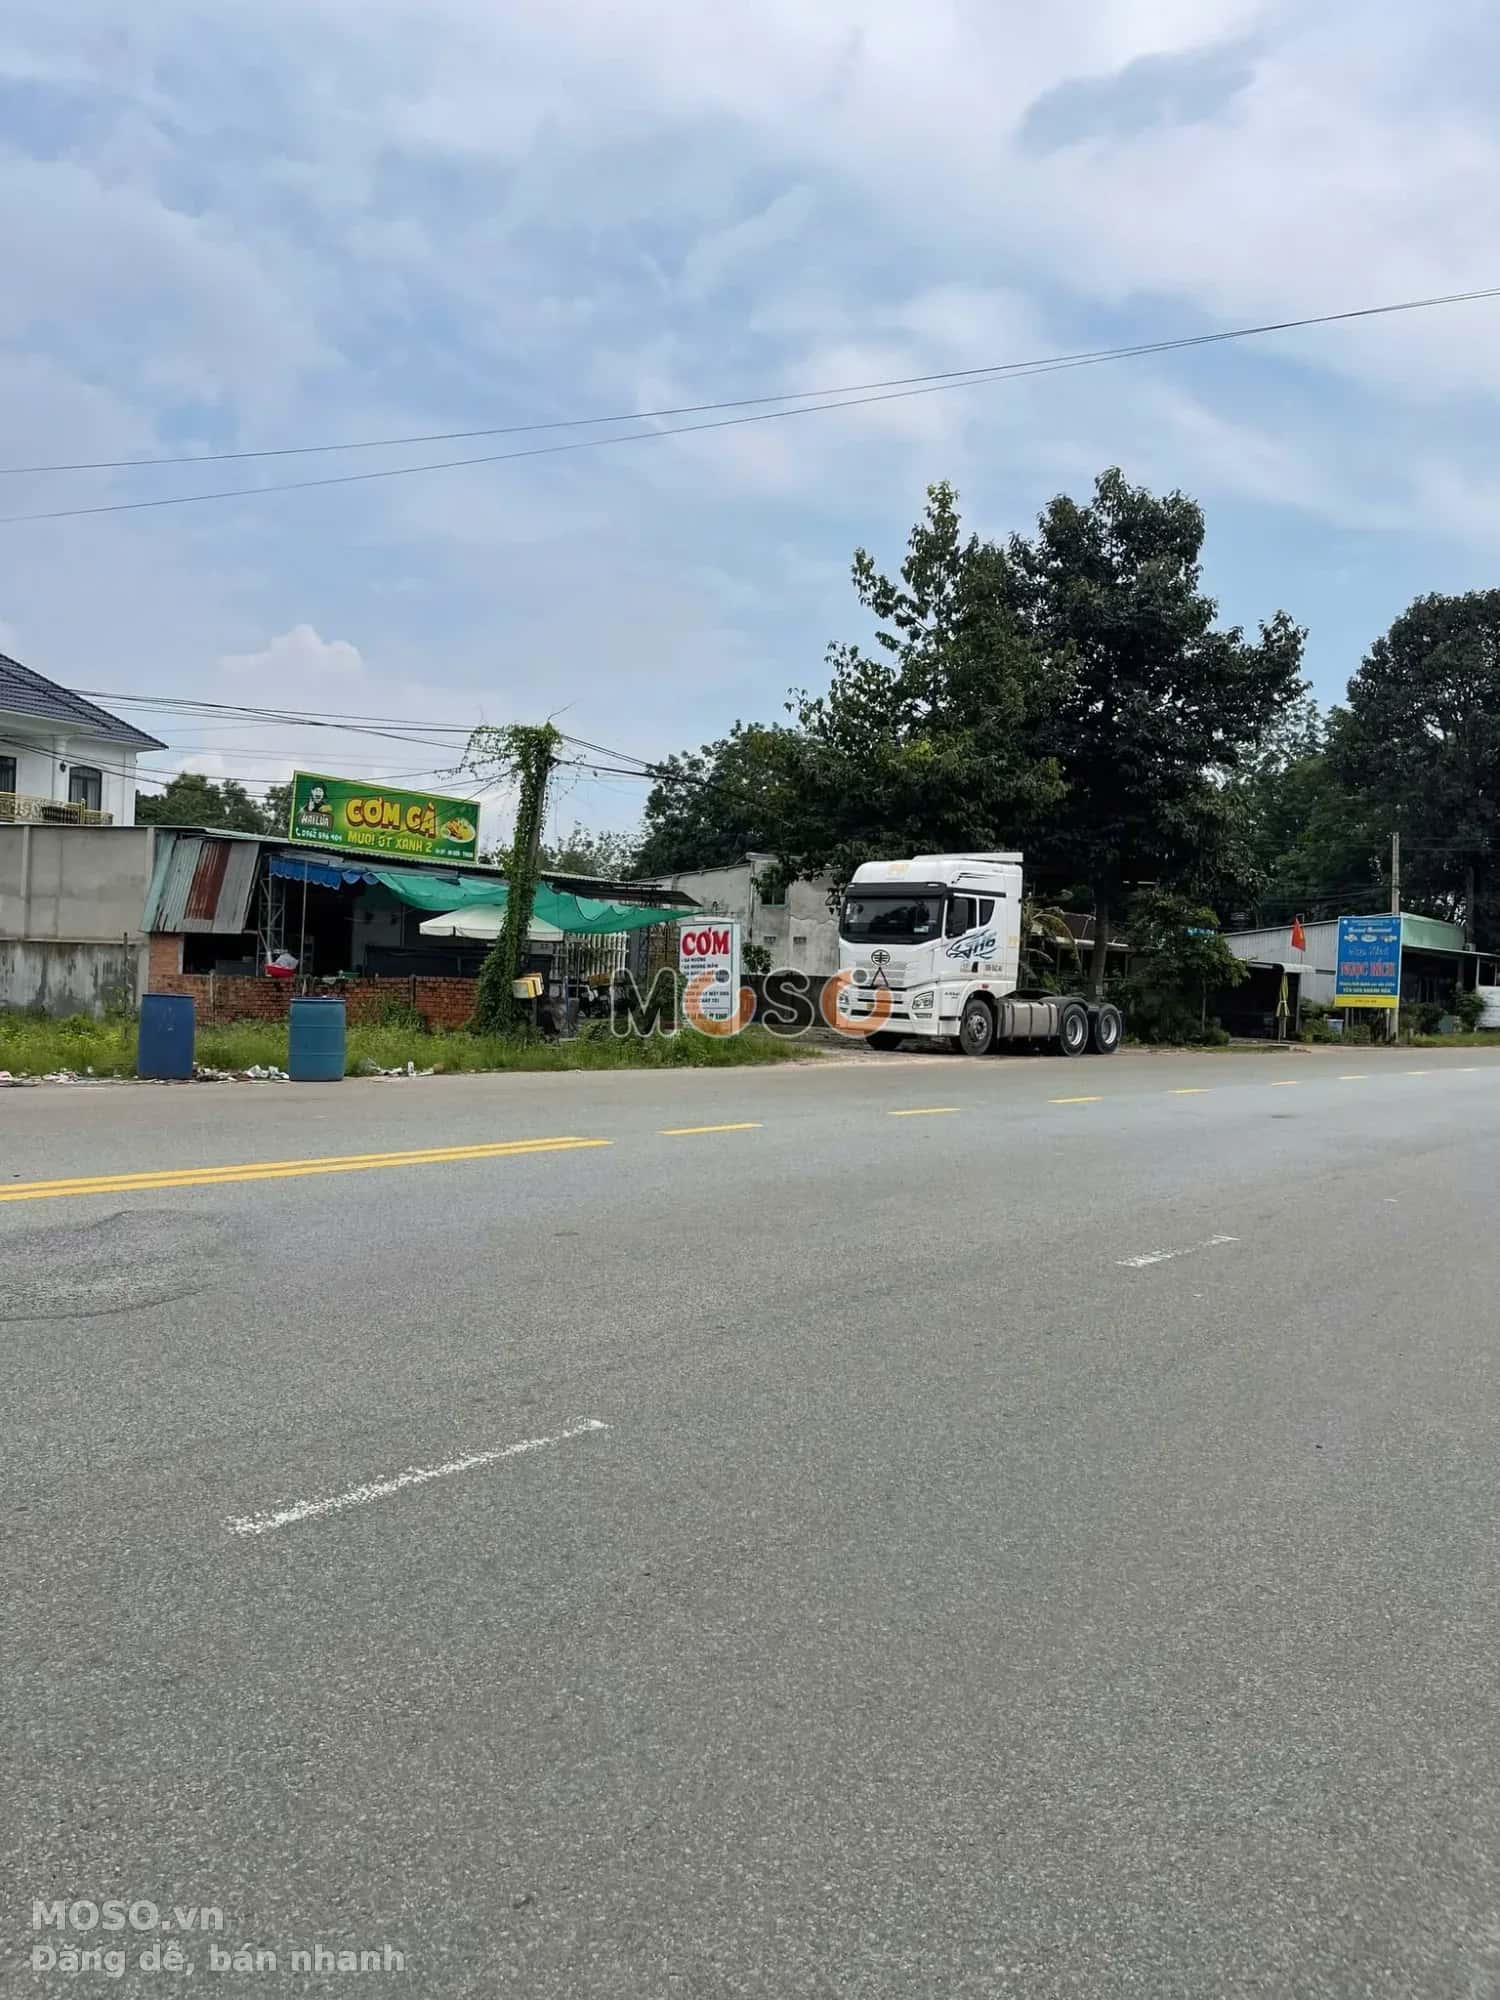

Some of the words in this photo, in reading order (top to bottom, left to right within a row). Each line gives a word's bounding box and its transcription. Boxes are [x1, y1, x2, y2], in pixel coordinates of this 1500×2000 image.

[346, 796, 401, 829] CƠM
[406, 801, 437, 839] GÀ
[395, 837, 423, 852] XANH
[425, 842, 433, 853] 2
[682, 926, 730, 957] CƠM
